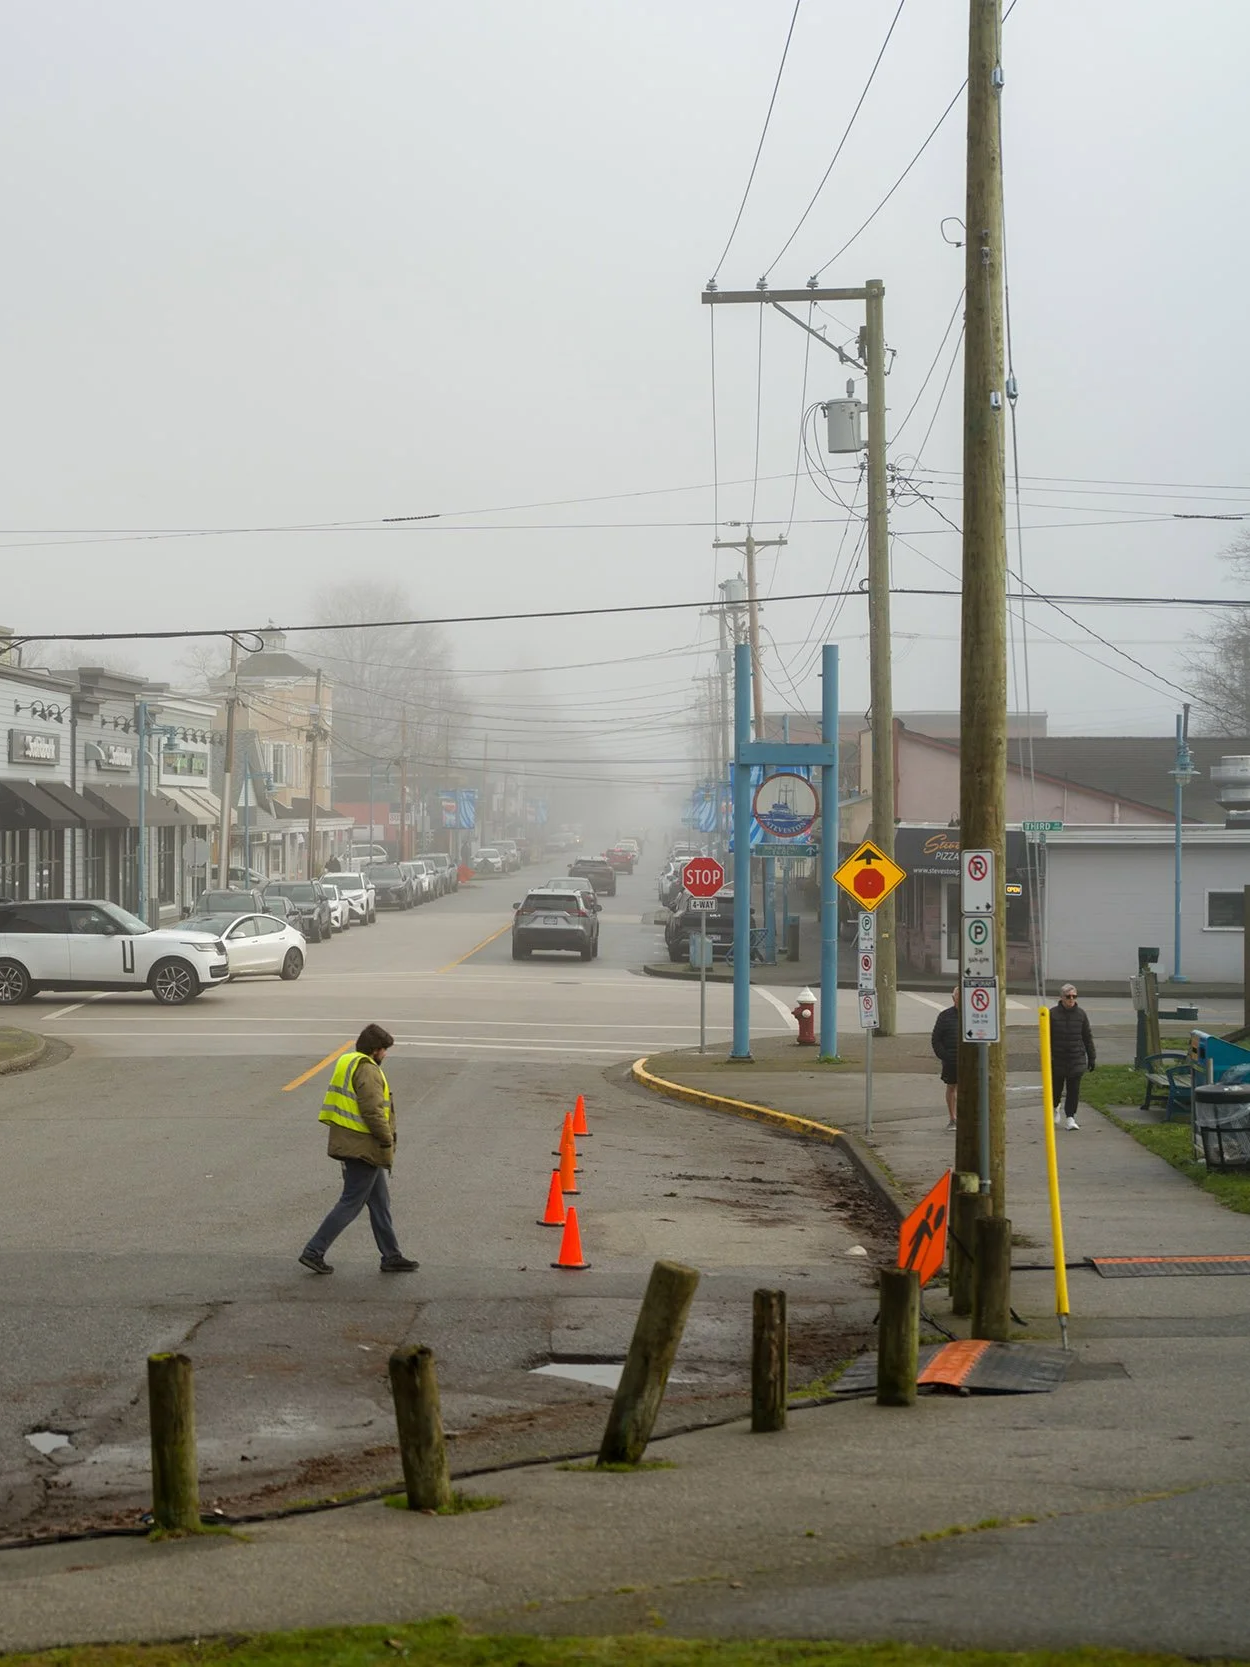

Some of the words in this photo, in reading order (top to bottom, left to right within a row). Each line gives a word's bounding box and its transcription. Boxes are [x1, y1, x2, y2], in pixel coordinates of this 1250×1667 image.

[765, 820, 807, 833] STEVESTON
[1025, 822, 1051, 831] THIRD
[935, 851, 960, 861] PIZZA
[686, 869, 721, 885] STOP
[692, 901, 714, 909] 4-WAY
